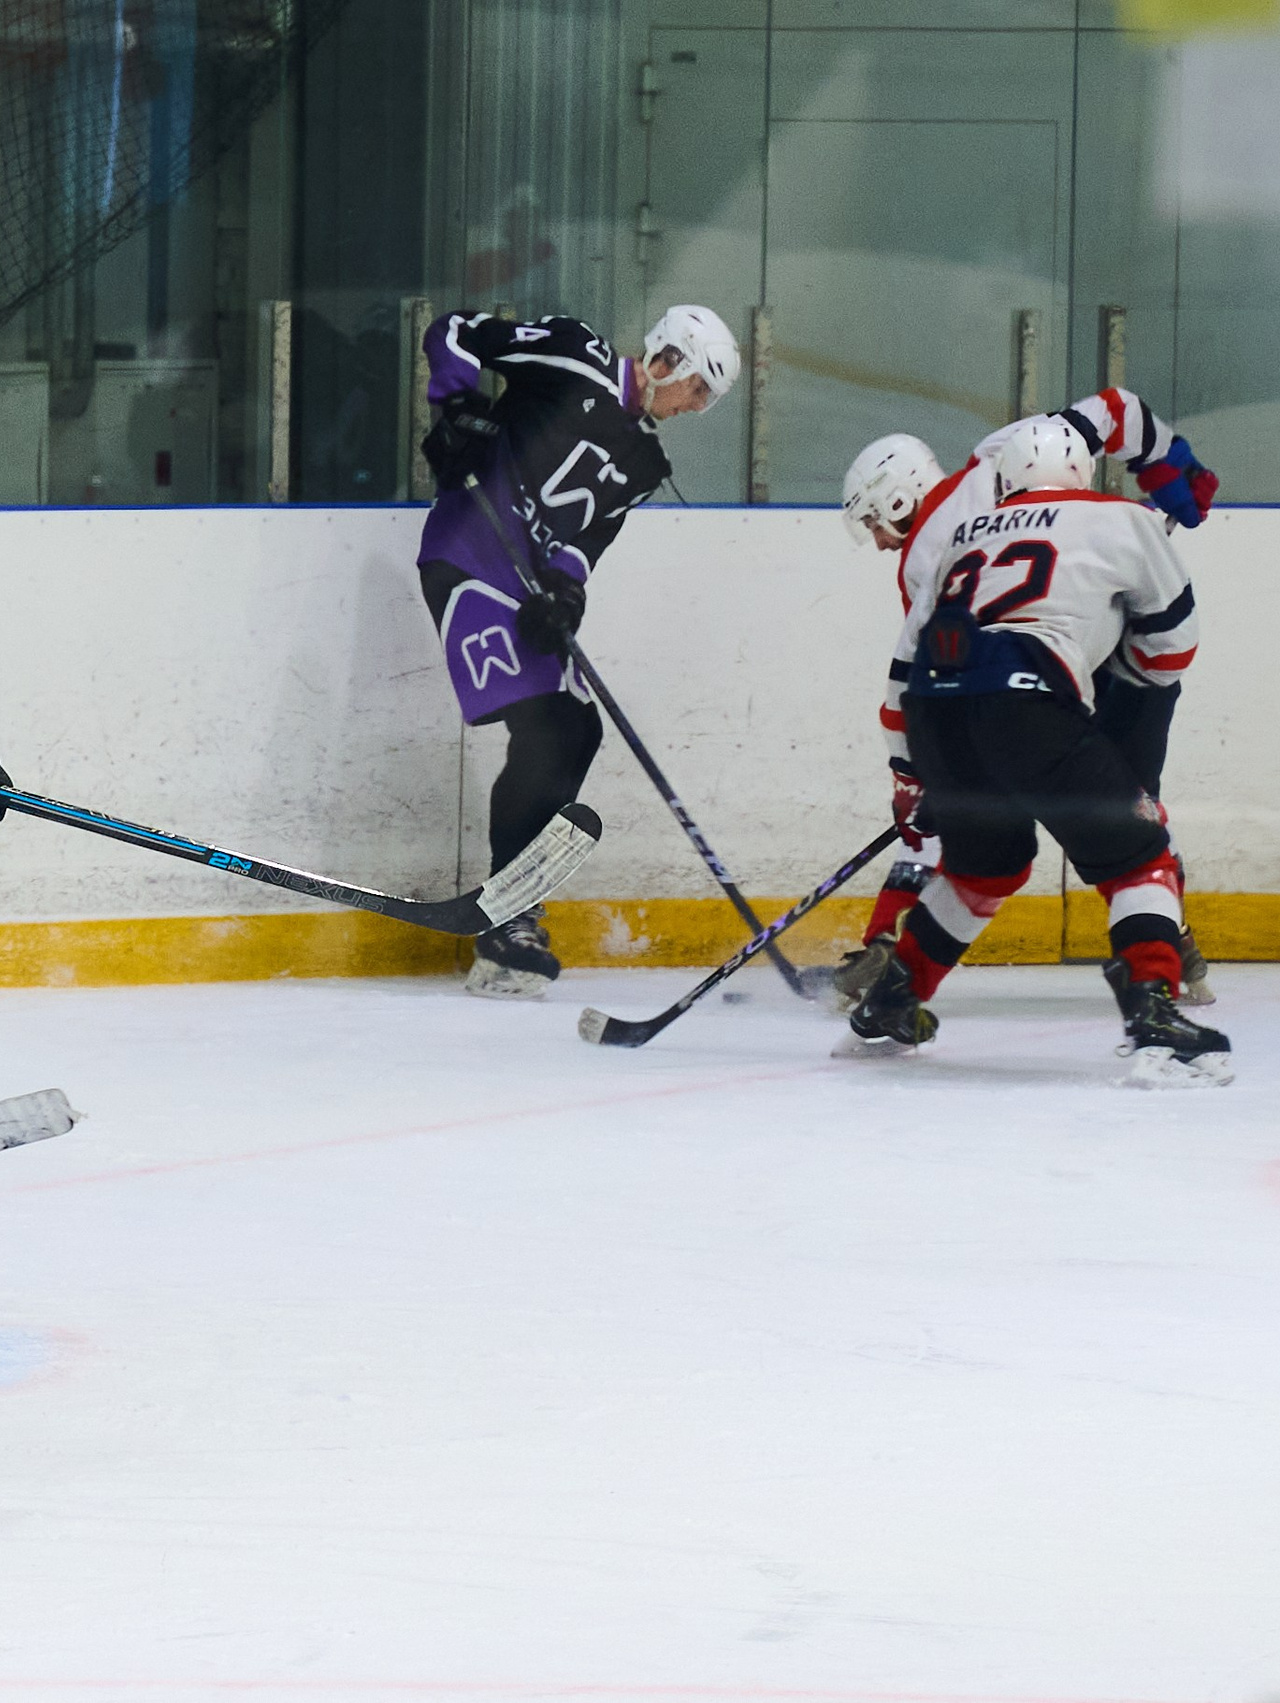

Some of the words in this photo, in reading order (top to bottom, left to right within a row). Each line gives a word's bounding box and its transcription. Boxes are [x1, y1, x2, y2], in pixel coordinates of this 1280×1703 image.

[951, 508, 1060, 547] APARIN
[227, 865, 250, 876] PRO
[255, 865, 387, 914] NEXUS
